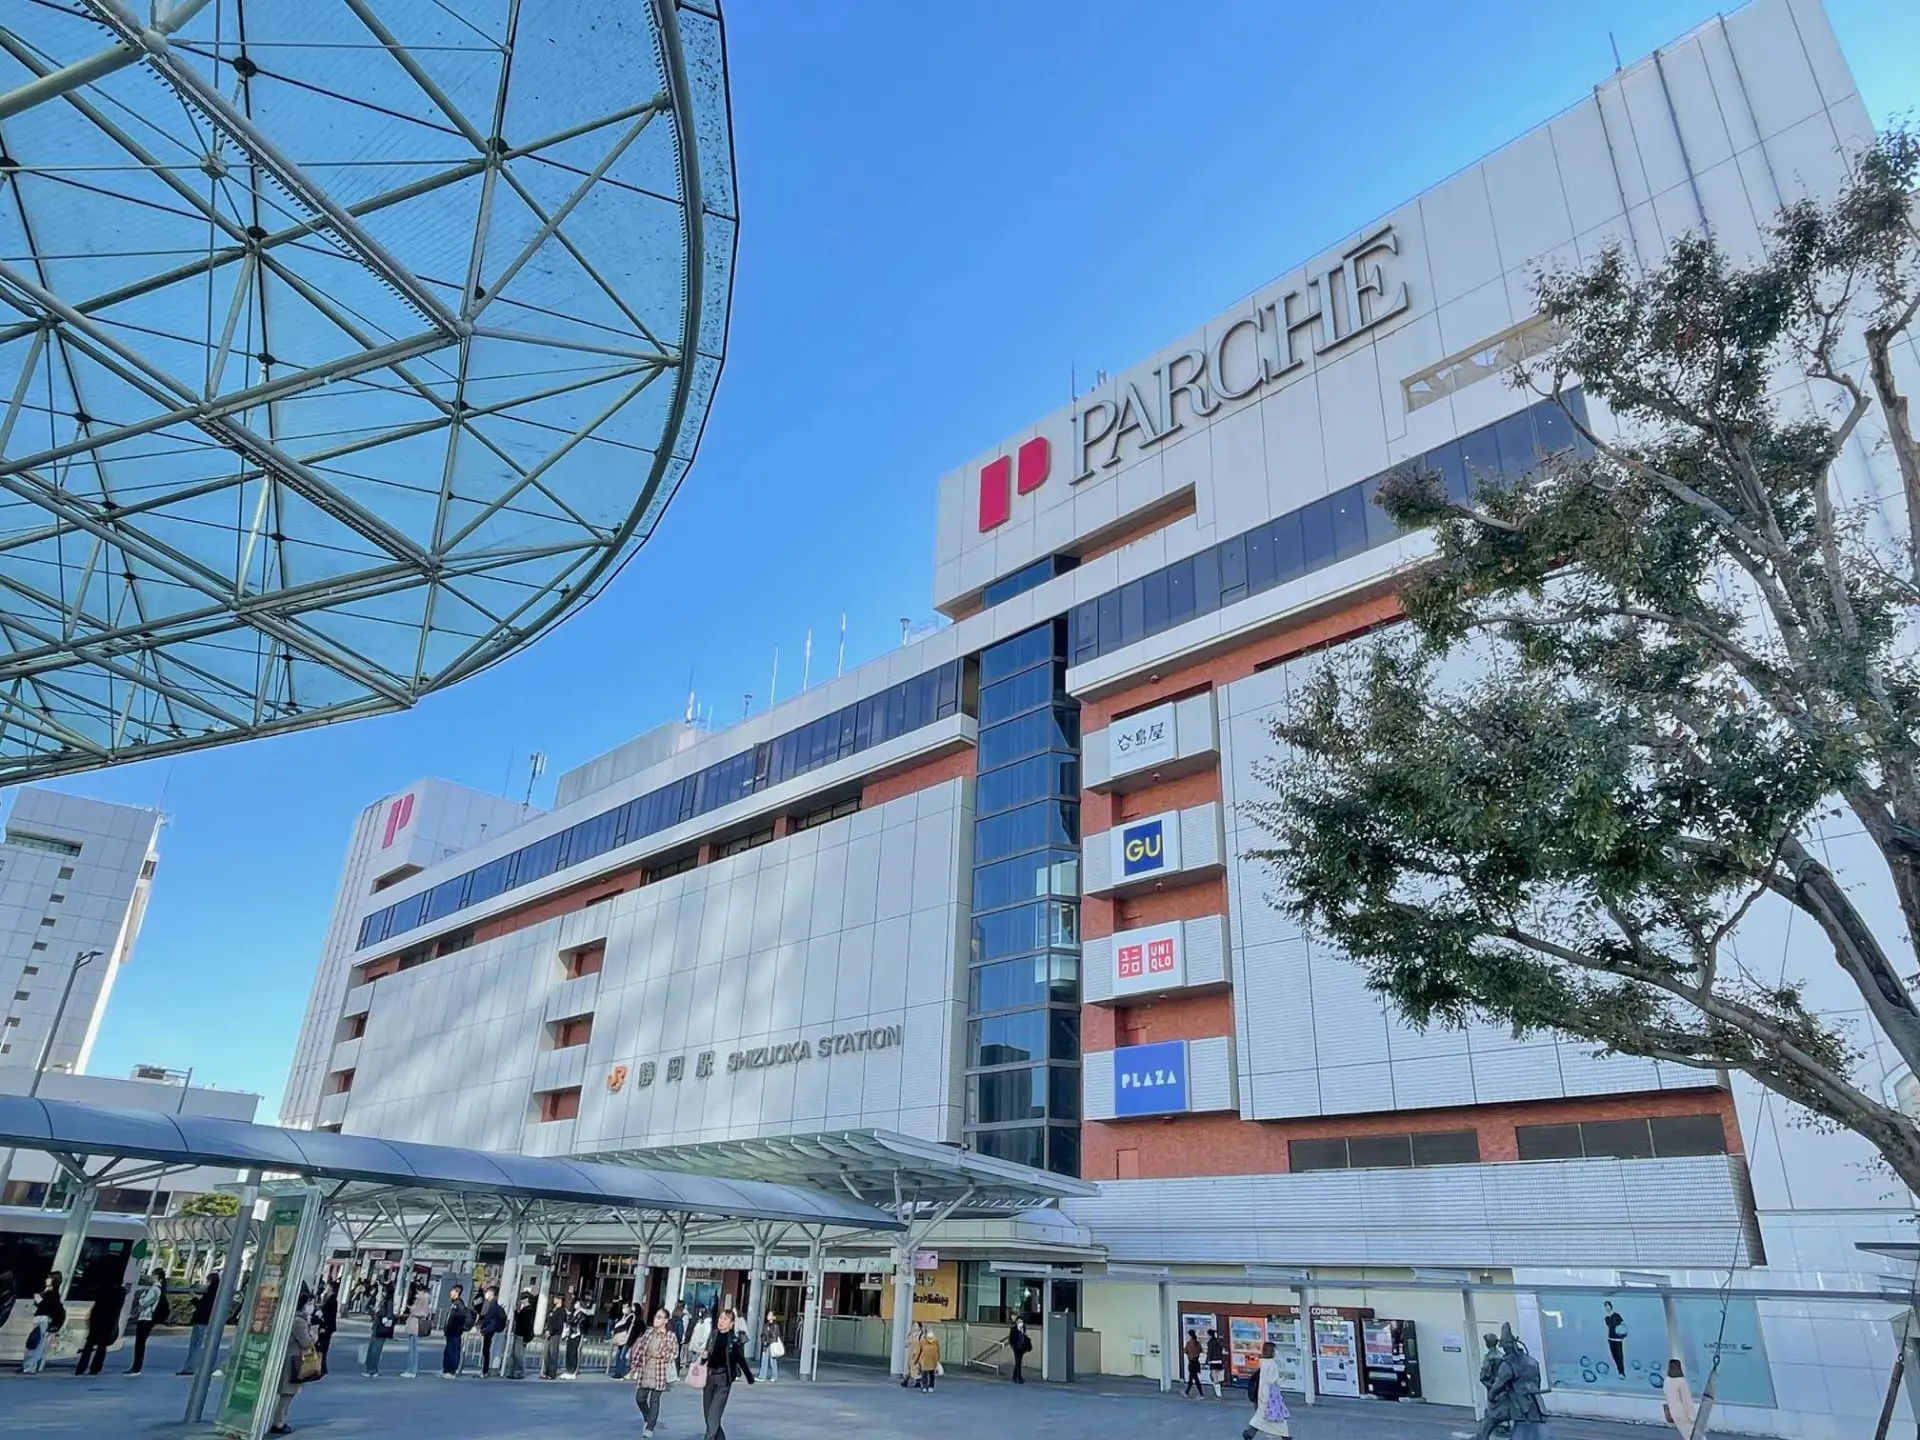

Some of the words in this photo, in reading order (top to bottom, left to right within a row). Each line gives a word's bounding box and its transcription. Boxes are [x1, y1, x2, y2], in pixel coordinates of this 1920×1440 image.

[1069, 223, 1409, 486] PARCHÉ
[1117, 722, 1164, 751] 谷島屋
[1126, 834, 1161, 862] GU
[727, 1040, 811, 1073] SHIZUOKA
[817, 1024, 901, 1058] STATION
[1121, 1070, 1177, 1089] PLAZA
[1311, 1307, 1338, 1316] CORNER
